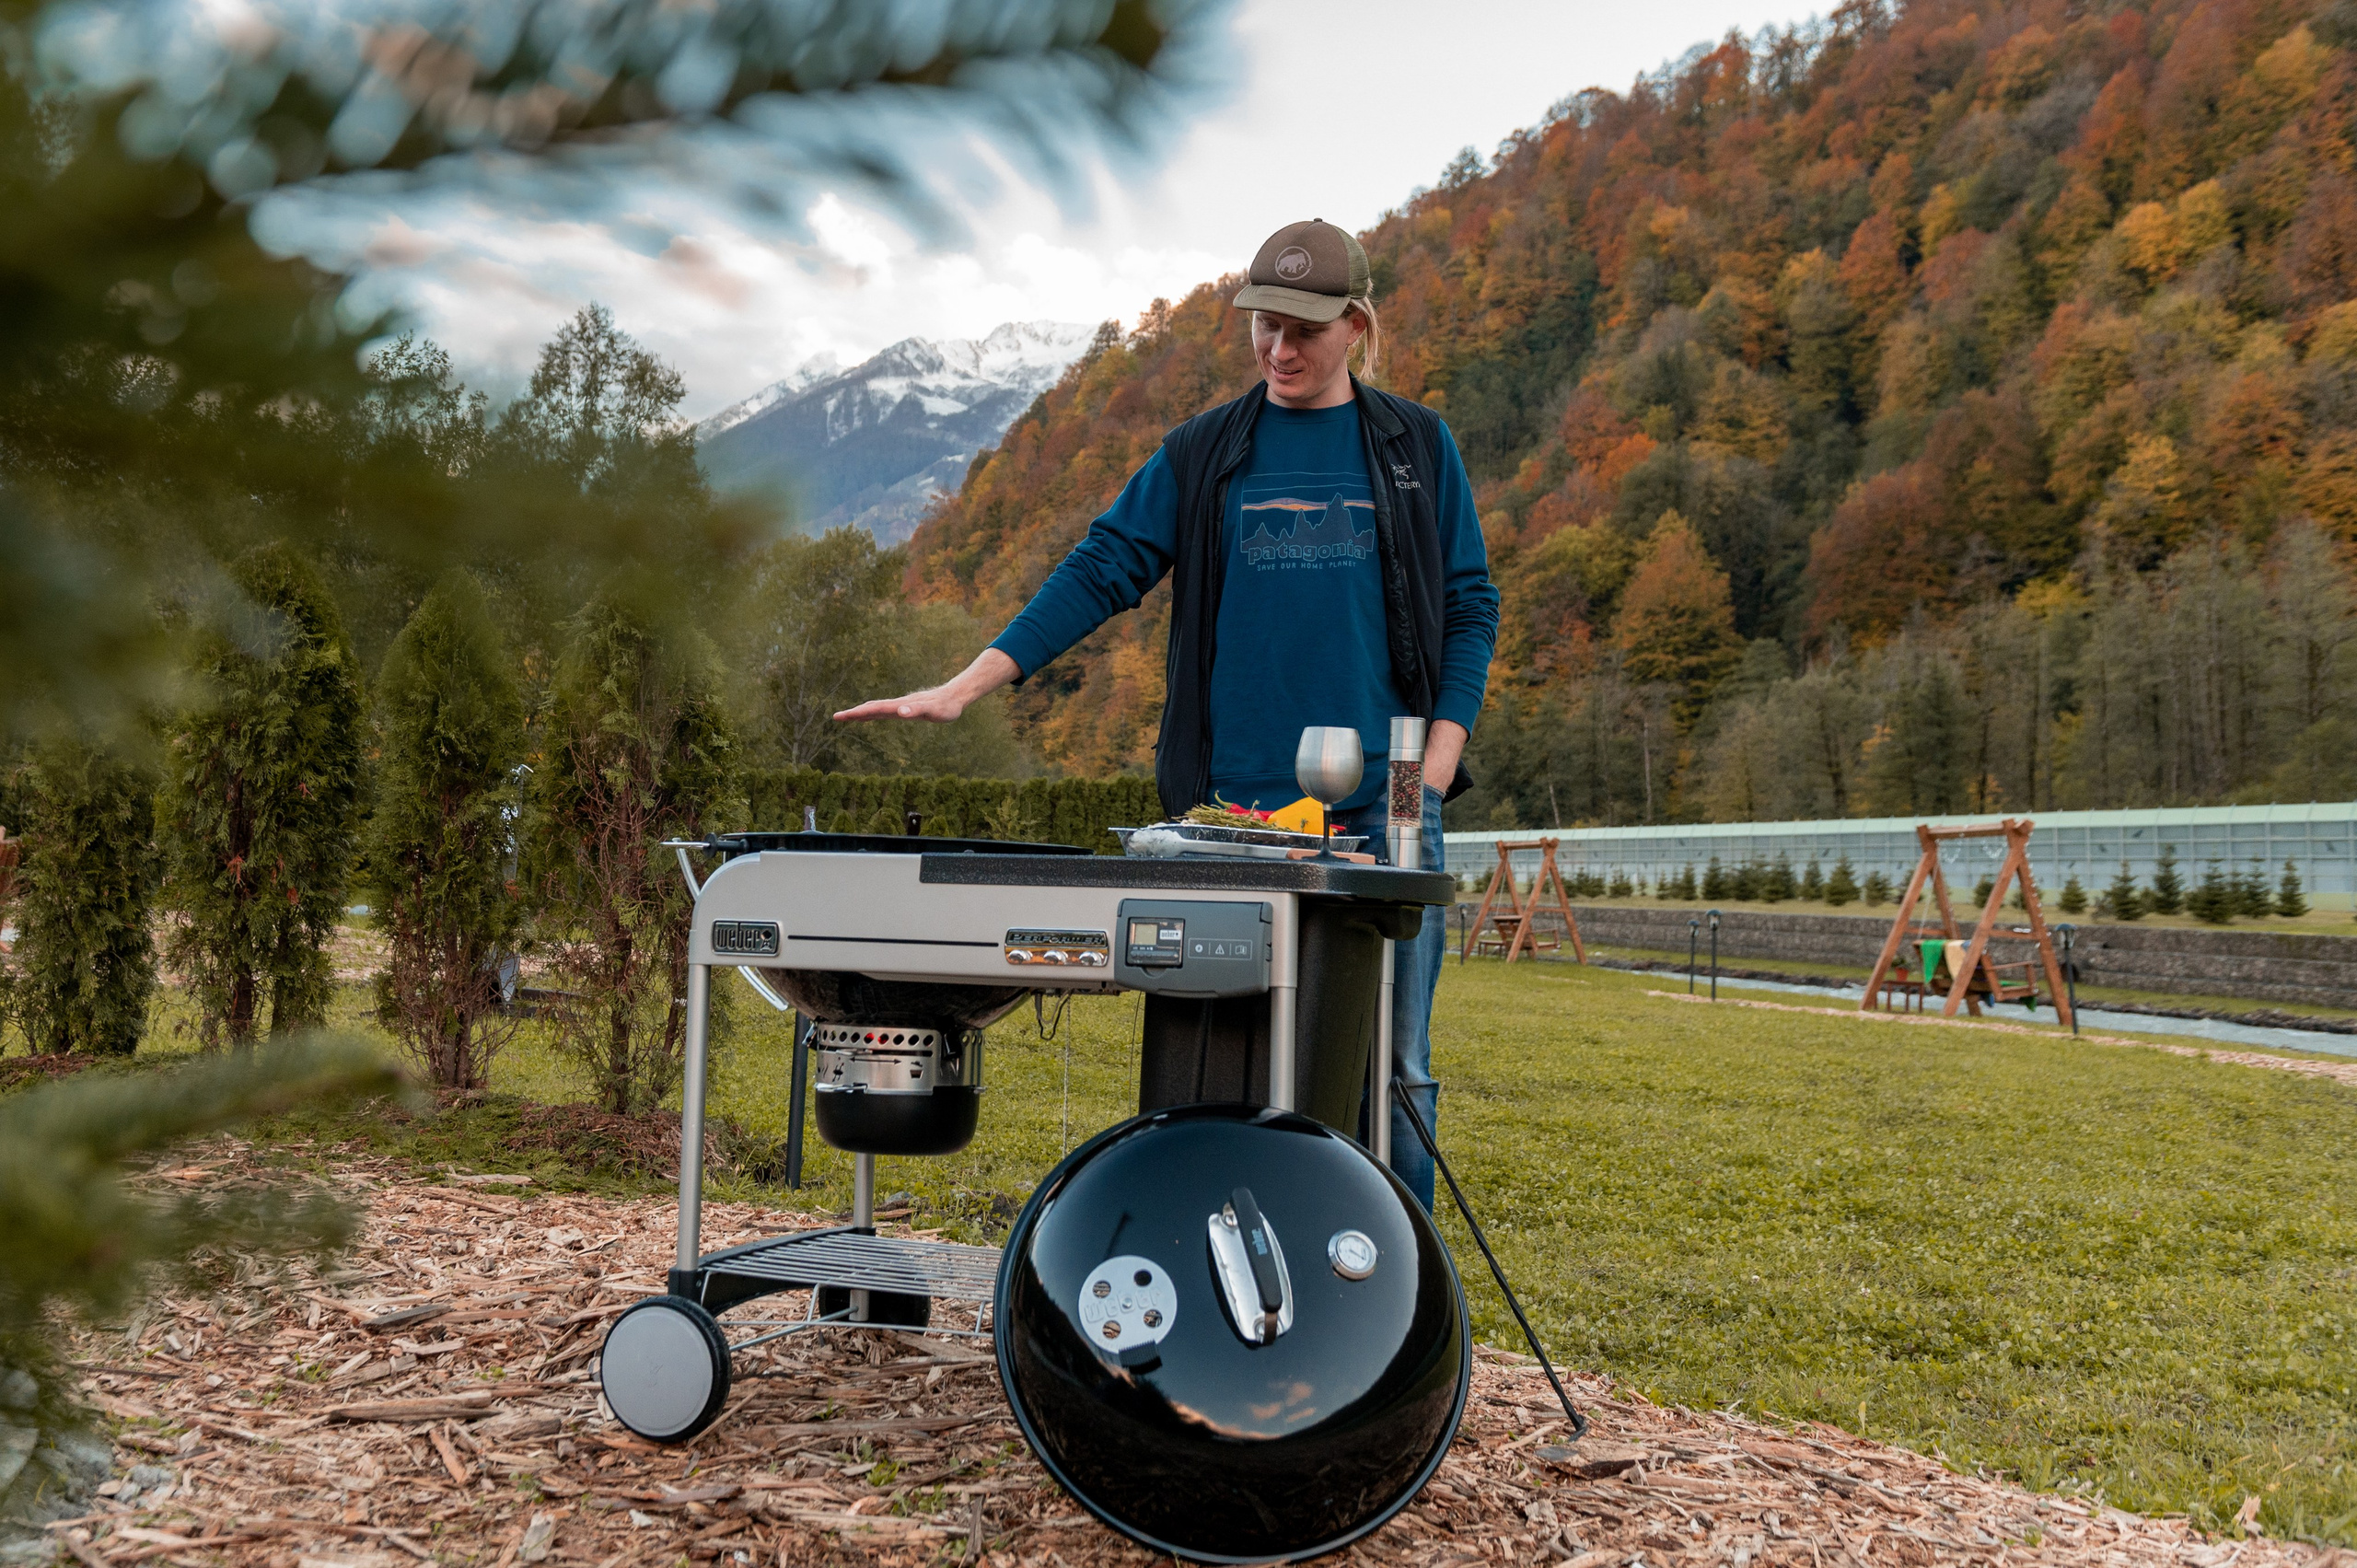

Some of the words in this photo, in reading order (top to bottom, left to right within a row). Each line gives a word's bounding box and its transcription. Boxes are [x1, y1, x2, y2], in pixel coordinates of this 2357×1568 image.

[1248, 539, 1366, 564] patagonia
[1257, 563, 1275, 572] SAVE
[1280, 562, 1296, 570] OUR
[1301, 562, 1323, 570] HOME
[1329, 560, 1357, 569] PLANET
[716, 922, 761, 950] weber
[1007, 934, 1104, 944] PERFORMER
